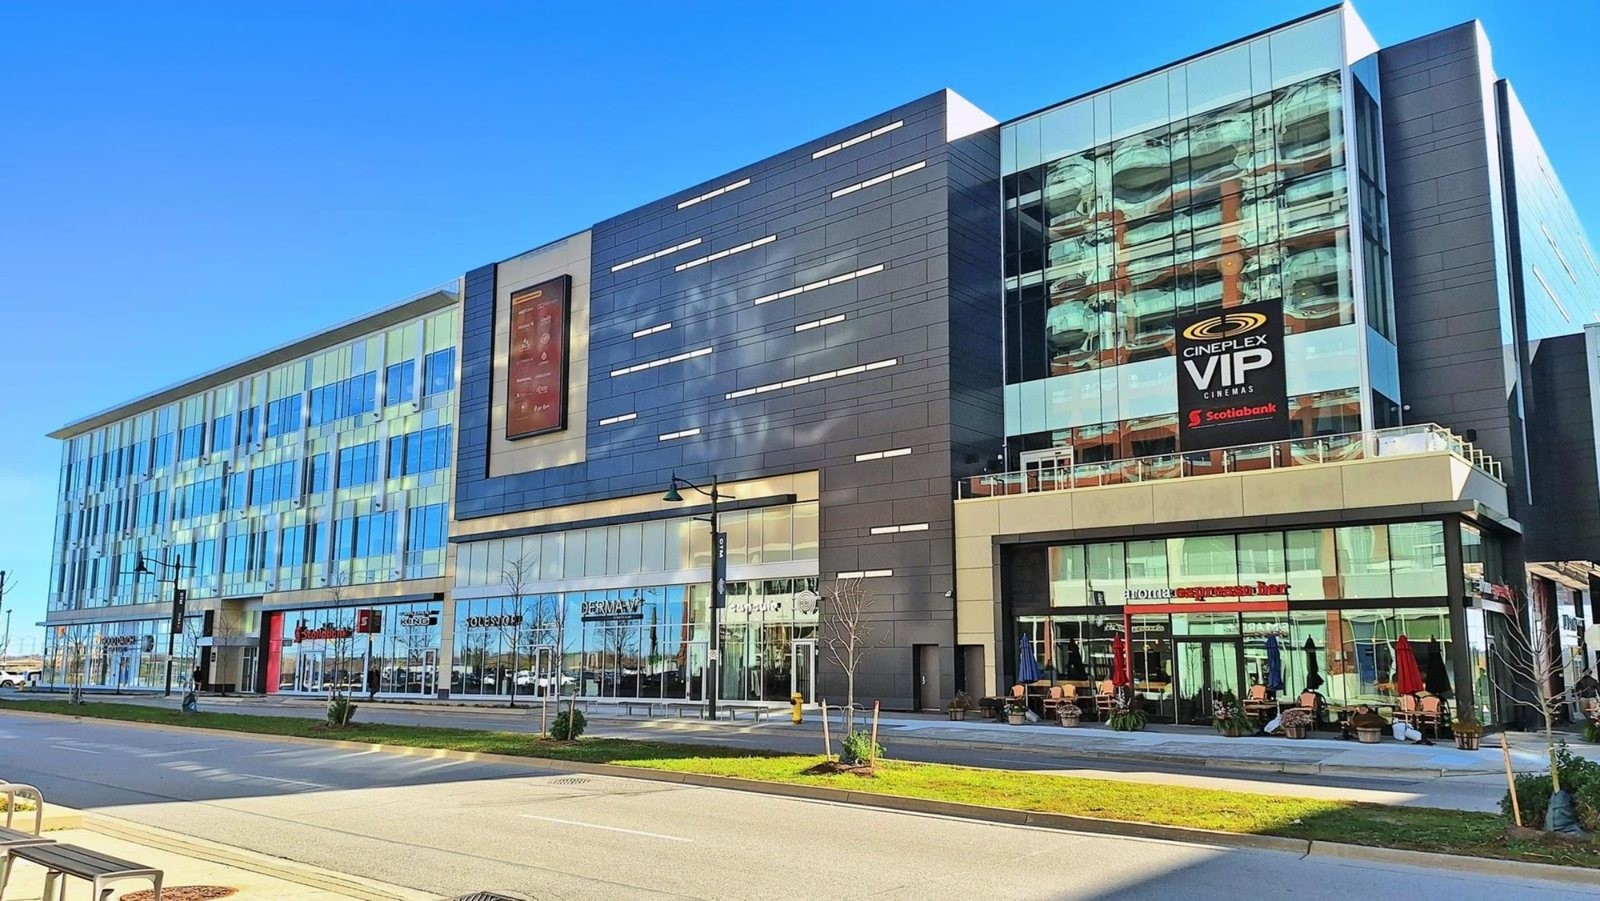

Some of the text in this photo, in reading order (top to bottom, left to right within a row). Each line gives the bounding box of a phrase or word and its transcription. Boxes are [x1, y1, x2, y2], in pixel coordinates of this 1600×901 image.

[1183, 334, 1268, 357] CINEPLEX
[1183, 347, 1273, 391] VIP
[1203, 385, 1254, 399] CINEMAS
[1206, 403, 1277, 421] Scotiabank
[1124, 581, 1288, 601] aroma espresso bar
[400, 616, 432, 626] KING
